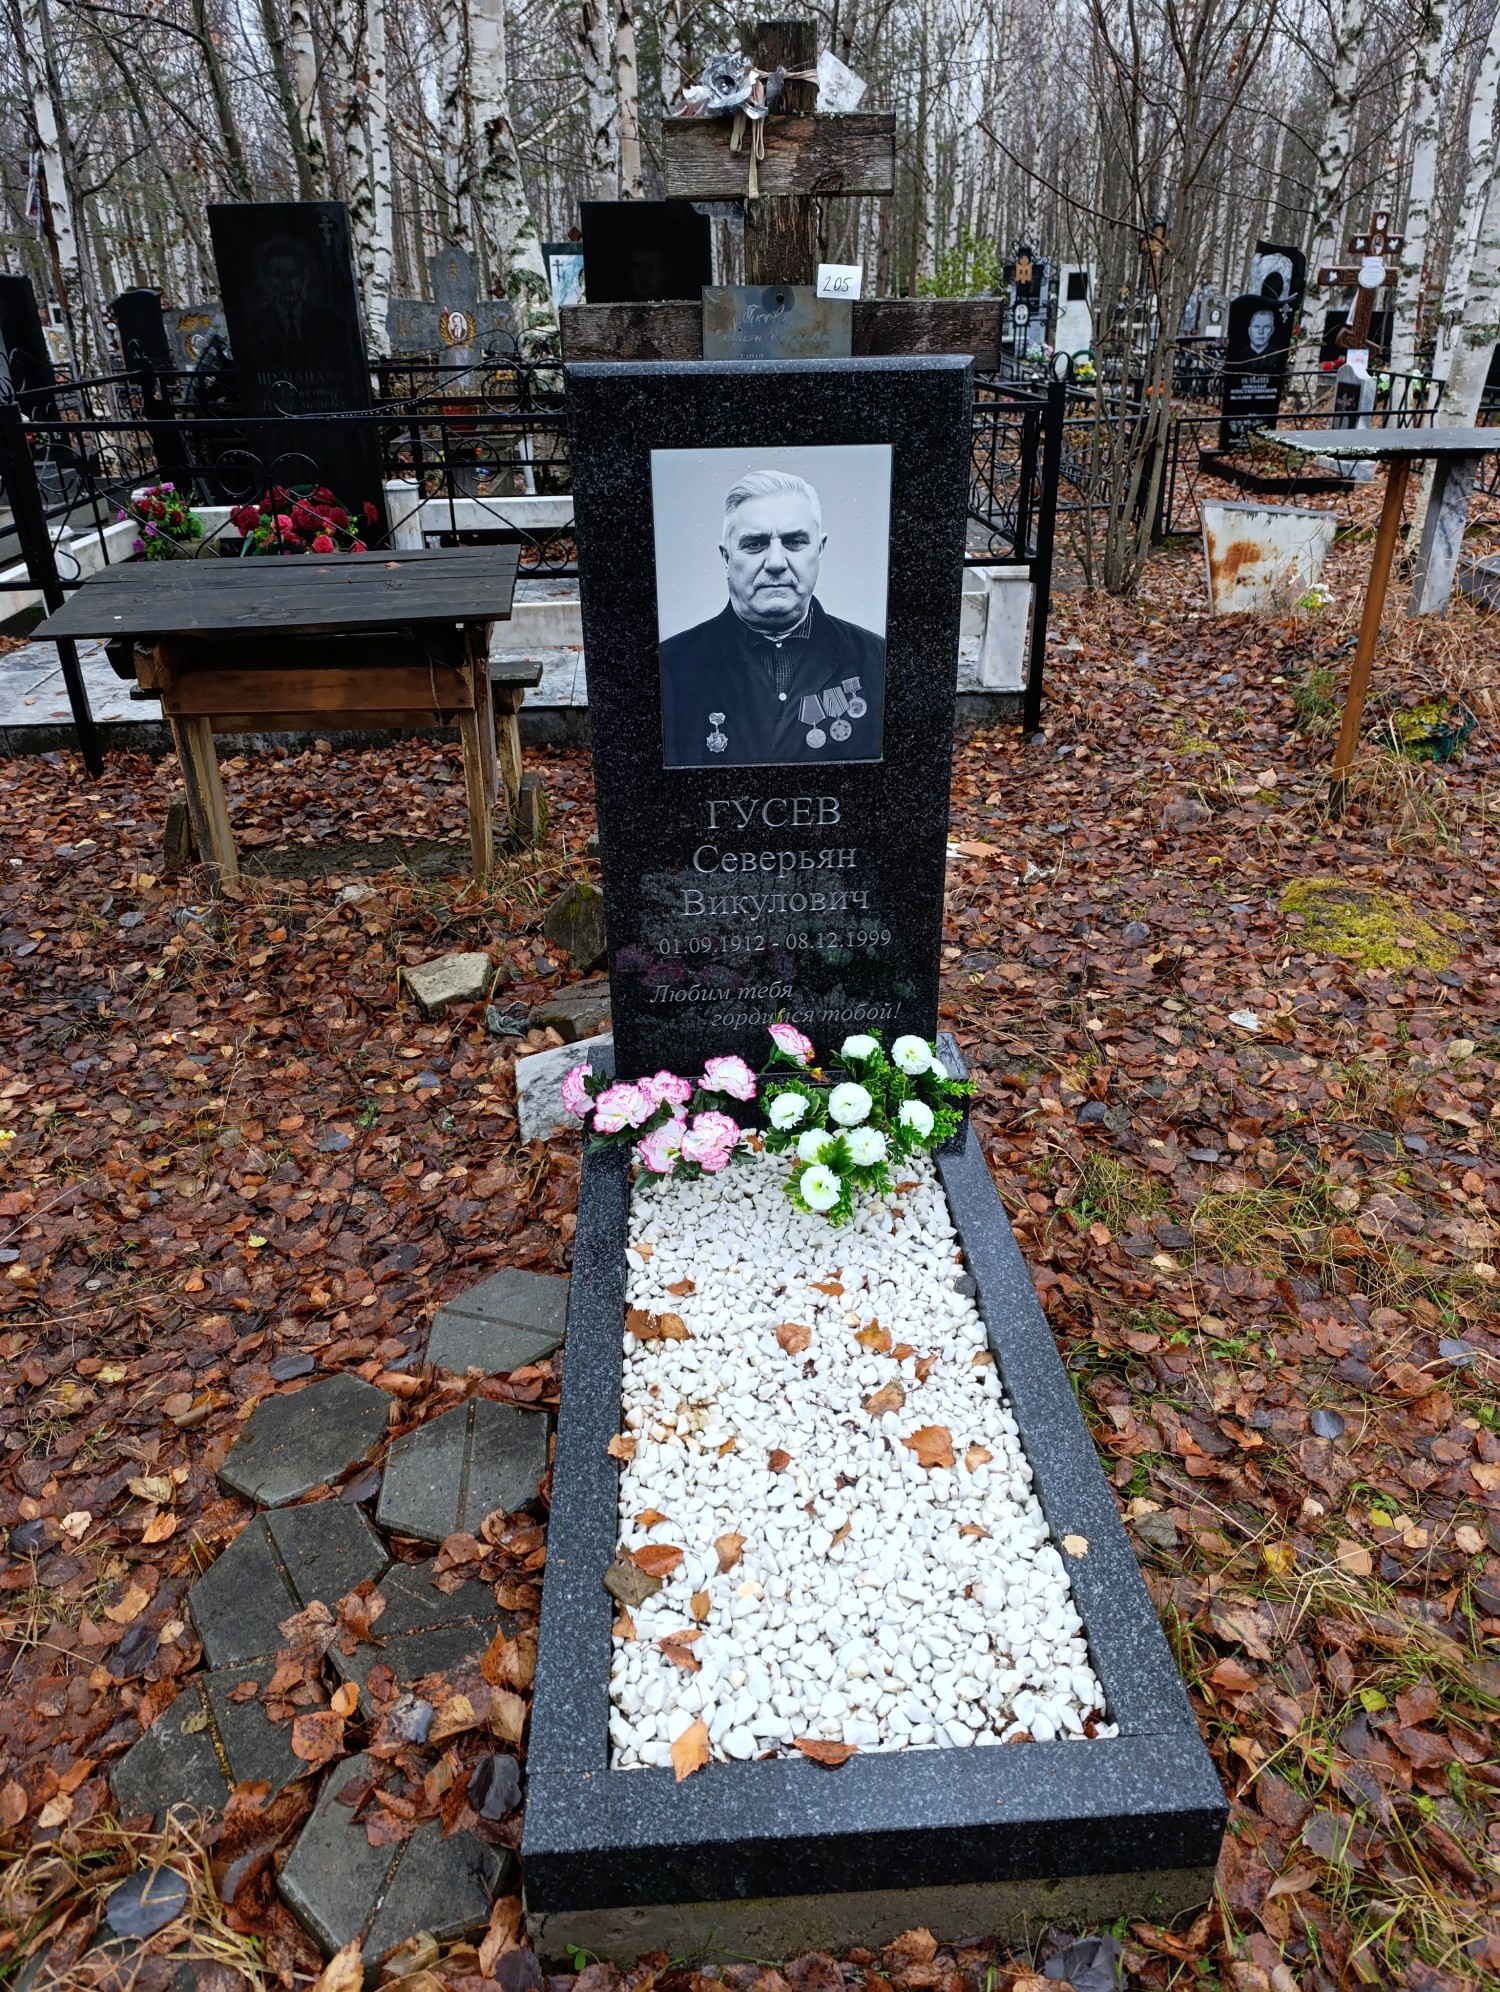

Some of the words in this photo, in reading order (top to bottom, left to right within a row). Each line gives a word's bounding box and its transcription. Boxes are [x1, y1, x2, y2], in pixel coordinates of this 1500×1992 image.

[822, 275, 854, 292] 205
[706, 796, 842, 829] ГУСЕВ
[693, 845, 857, 878] Северьян
[680, 889, 870, 921] Викулович
[659, 935, 766, 955] 01.09.1912
[785, 929, 892, 950] 08.12.1999
[649, 983, 731, 1004] Любим
[738, 980, 794, 1000] тебя
[821, 1002, 902, 1021] тобой!
